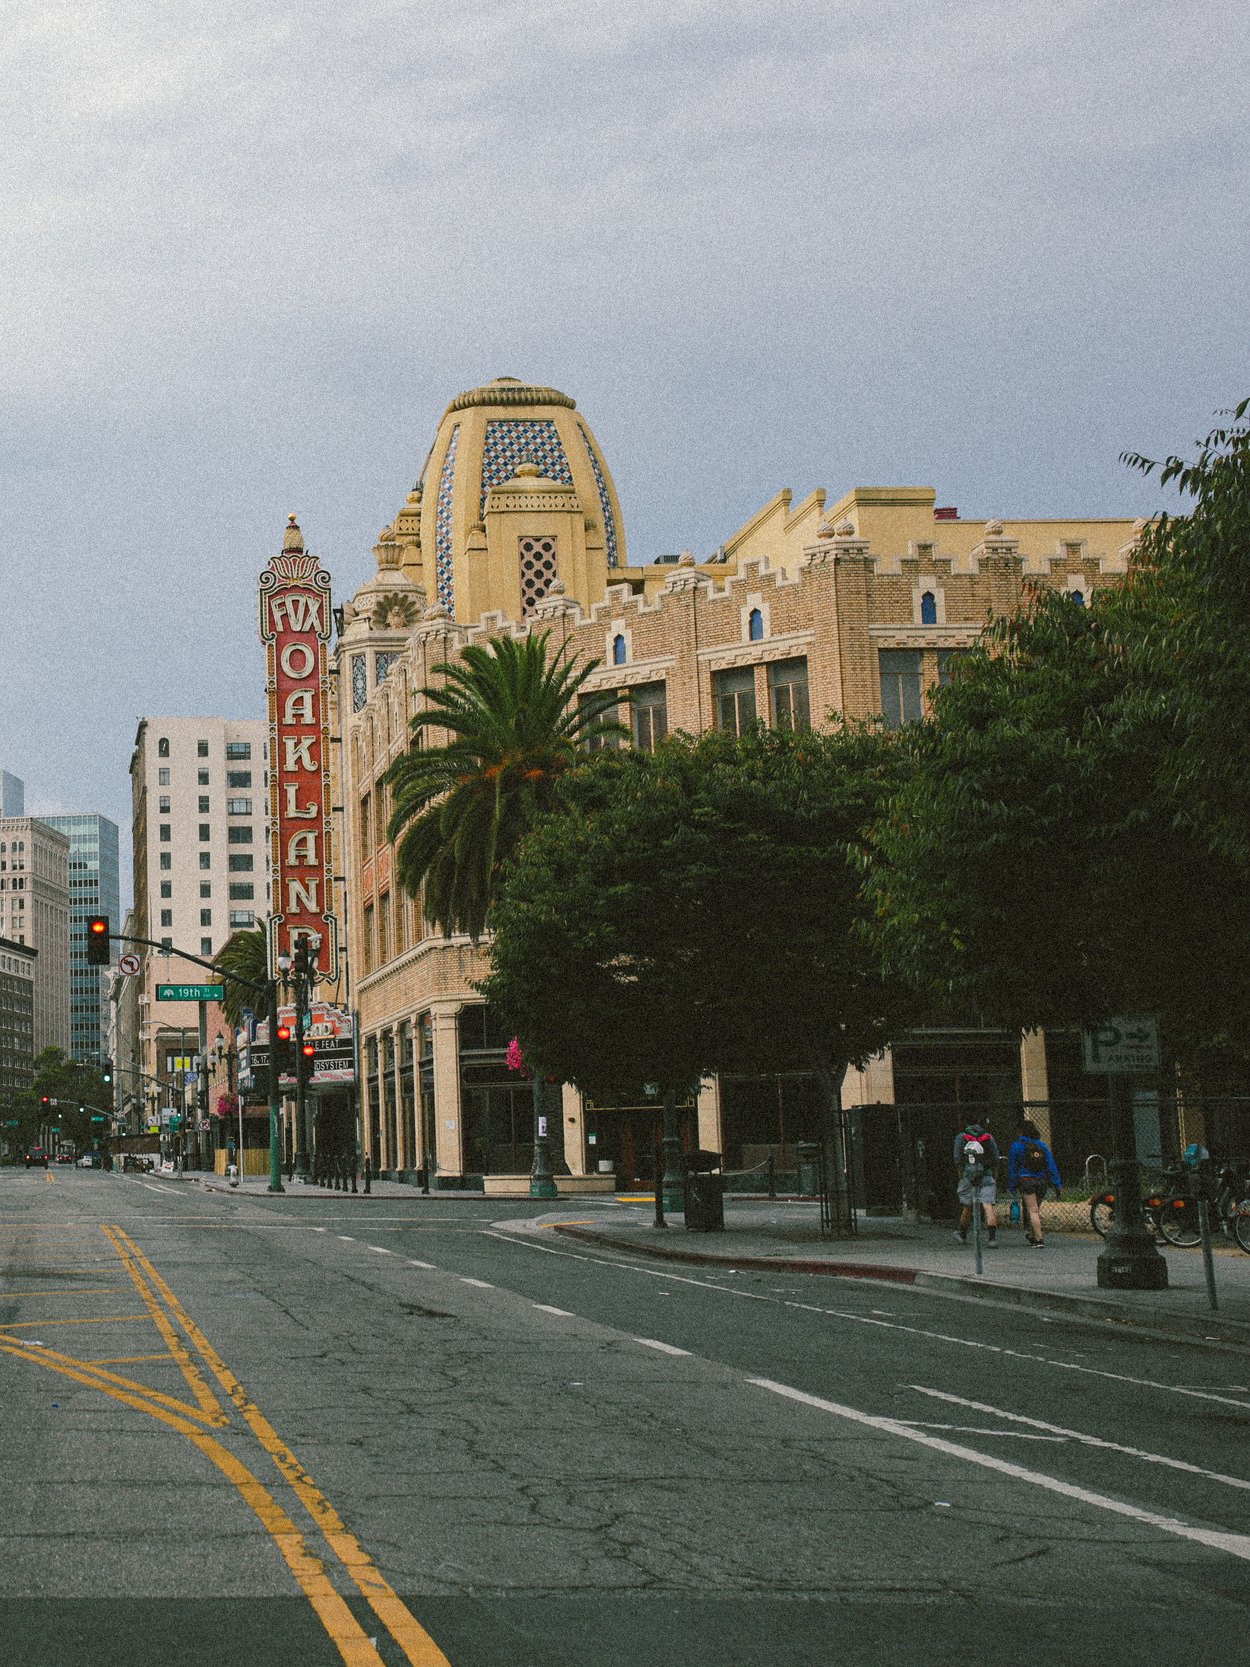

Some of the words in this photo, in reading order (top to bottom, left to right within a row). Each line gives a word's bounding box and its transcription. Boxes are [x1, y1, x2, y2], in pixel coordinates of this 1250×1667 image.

[270, 593, 322, 632] FOX
[178, 988, 201, 998] 19th
[321, 1040, 339, 1049] FEAT
[314, 1061, 349, 1071] DSYSTEM
